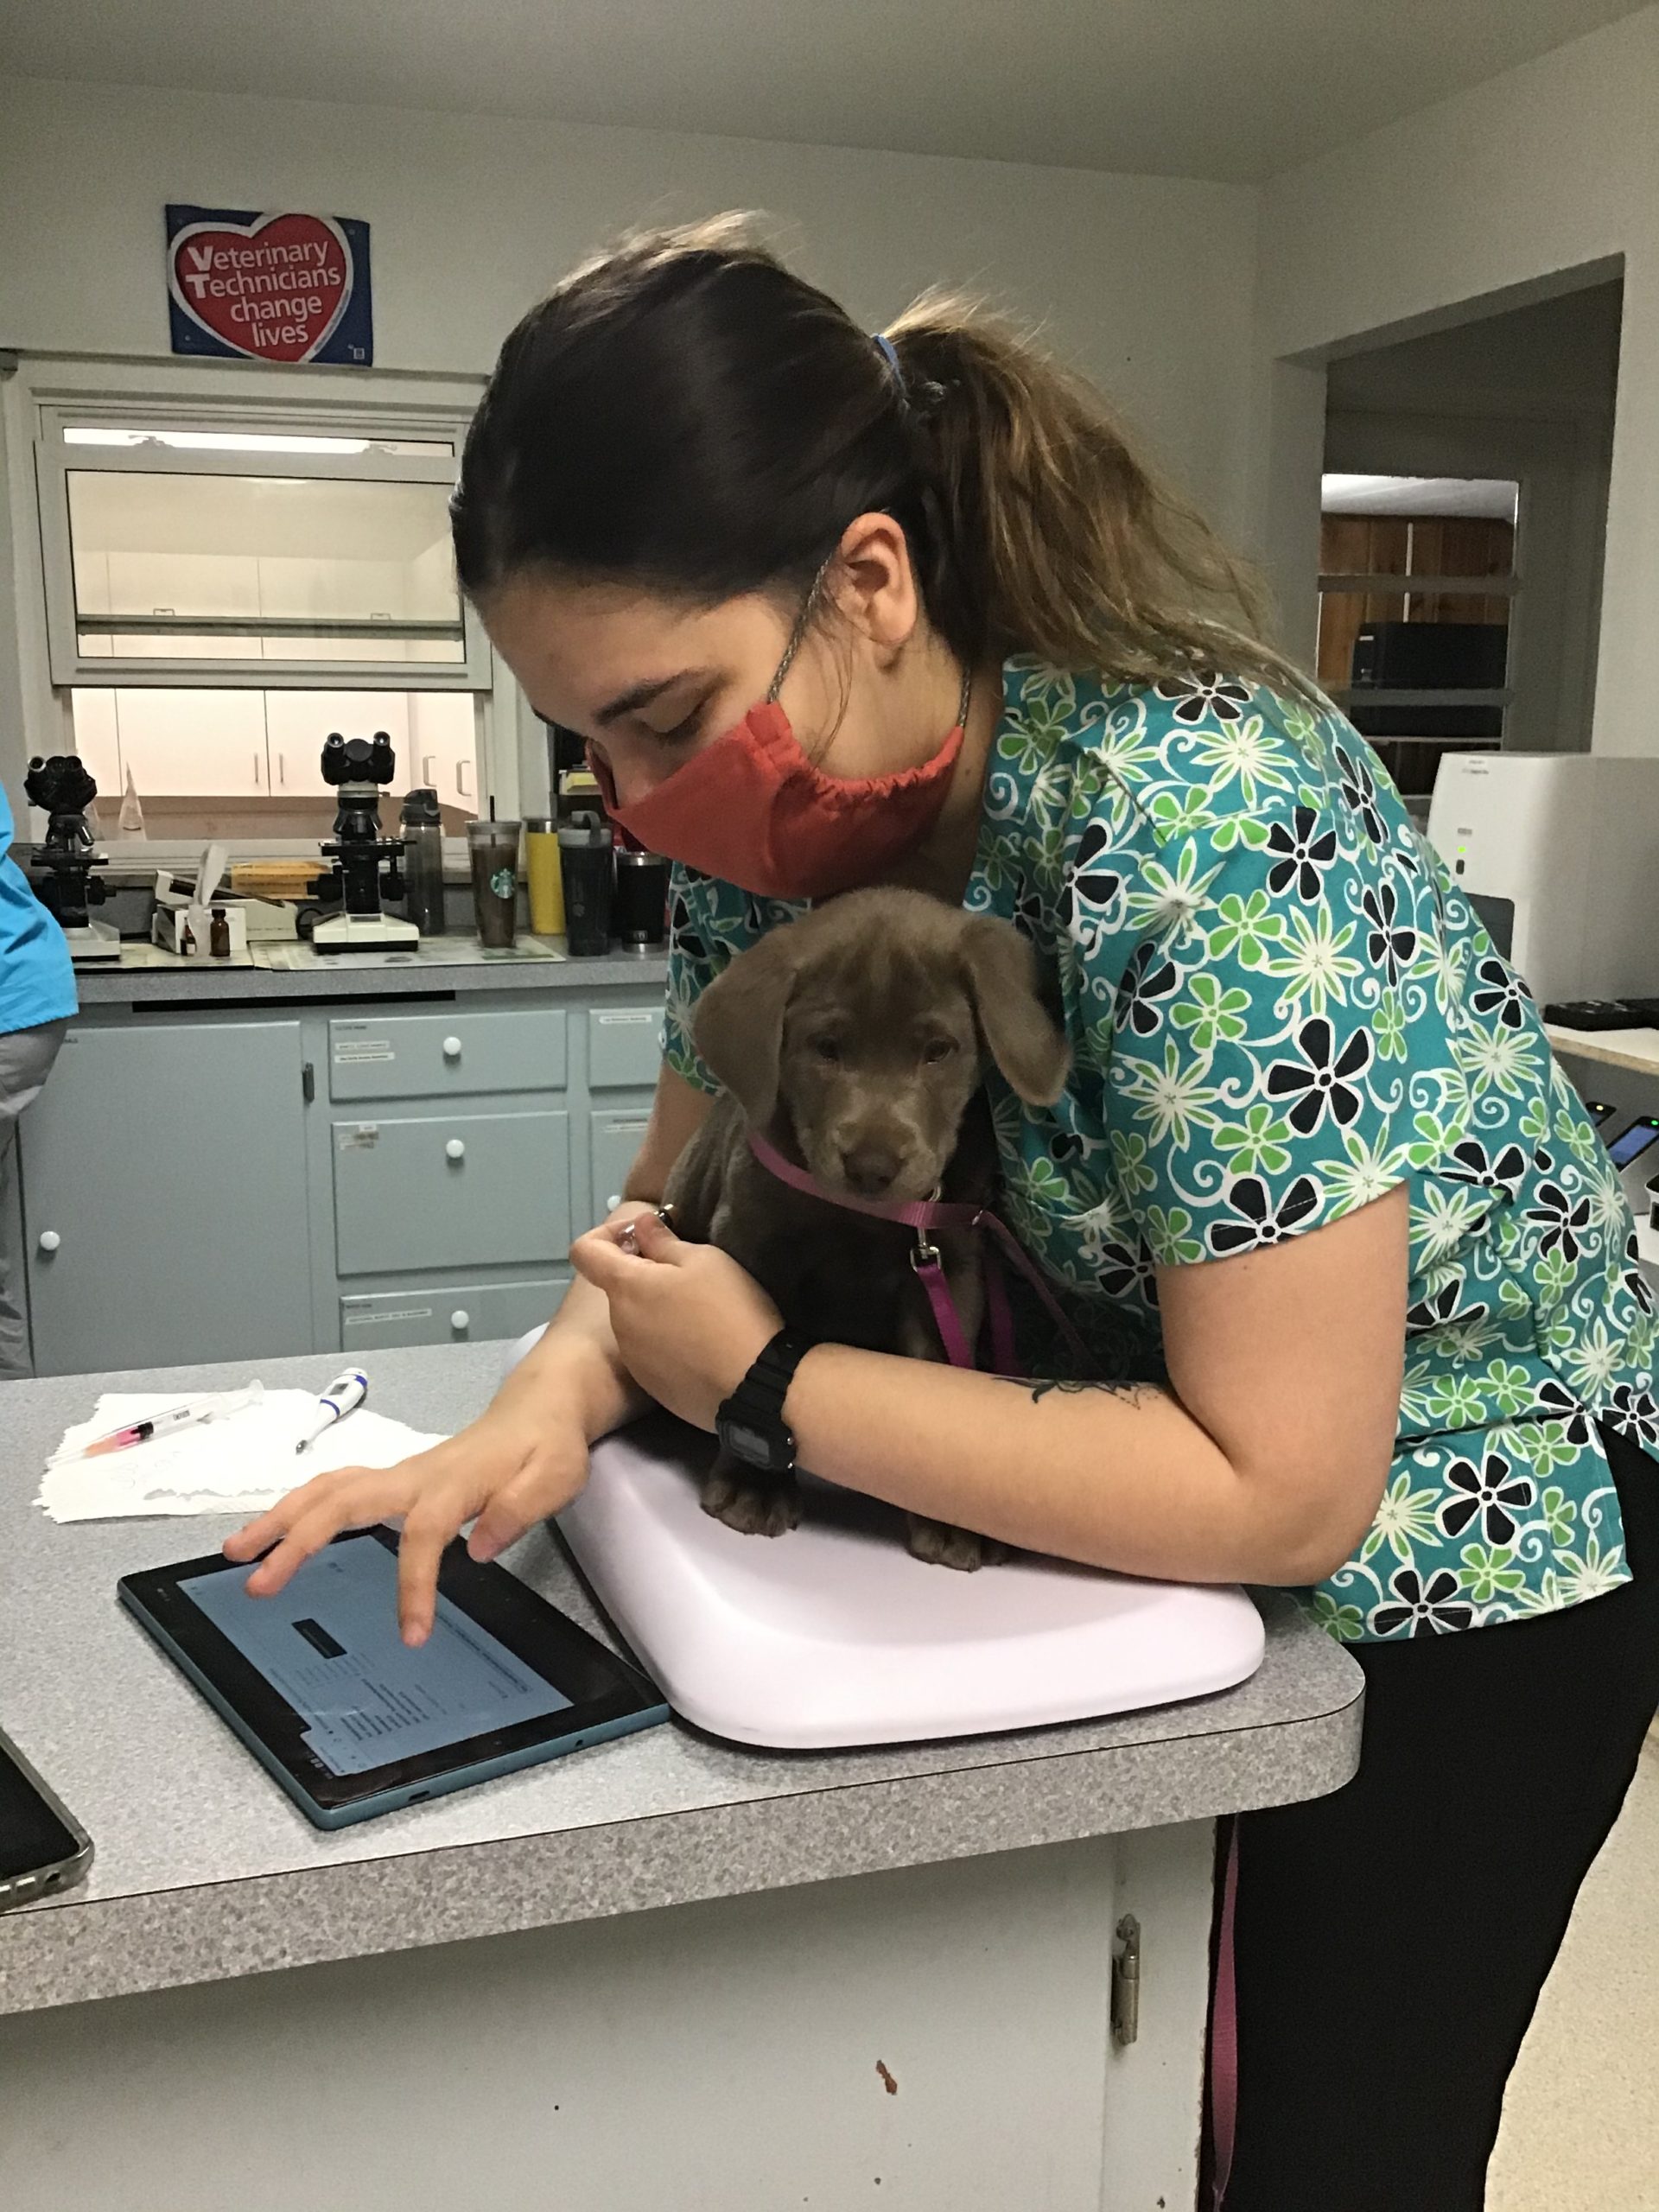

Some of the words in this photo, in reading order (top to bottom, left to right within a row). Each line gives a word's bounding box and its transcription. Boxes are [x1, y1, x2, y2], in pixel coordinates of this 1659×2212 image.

[188, 241, 328, 272] Veterinary
[185, 264, 341, 299] Technicians
[230, 296, 322, 322] change
[251, 322, 308, 347] lives
